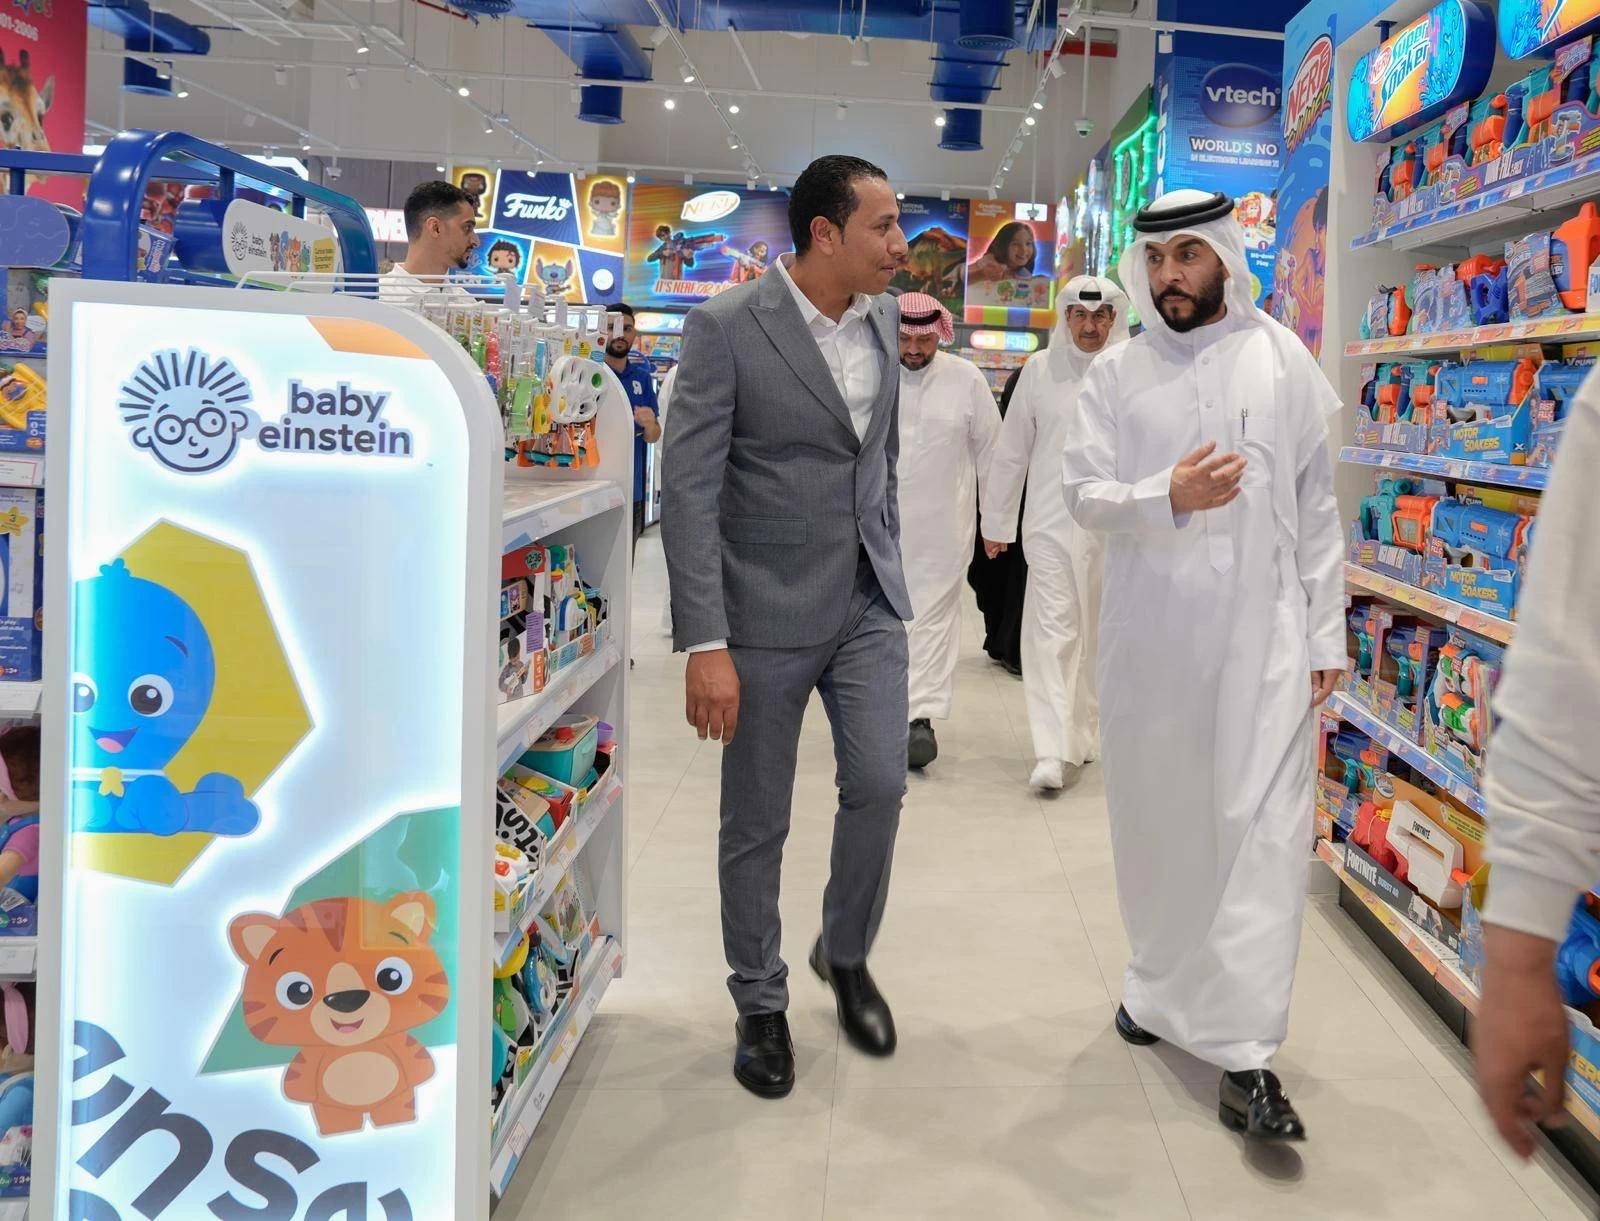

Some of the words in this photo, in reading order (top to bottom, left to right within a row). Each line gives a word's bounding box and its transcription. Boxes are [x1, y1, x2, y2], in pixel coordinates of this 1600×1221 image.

[1206, 86, 1276, 106] vtech
[1286, 44, 1330, 134] NERF
[1191, 138, 1253, 153] WORLD'S
[503, 193, 568, 221] Funko
[291, 384, 386, 423] baby
[258, 418, 411, 455] einstein
[1347, 848, 1377, 887] FORTNITE
